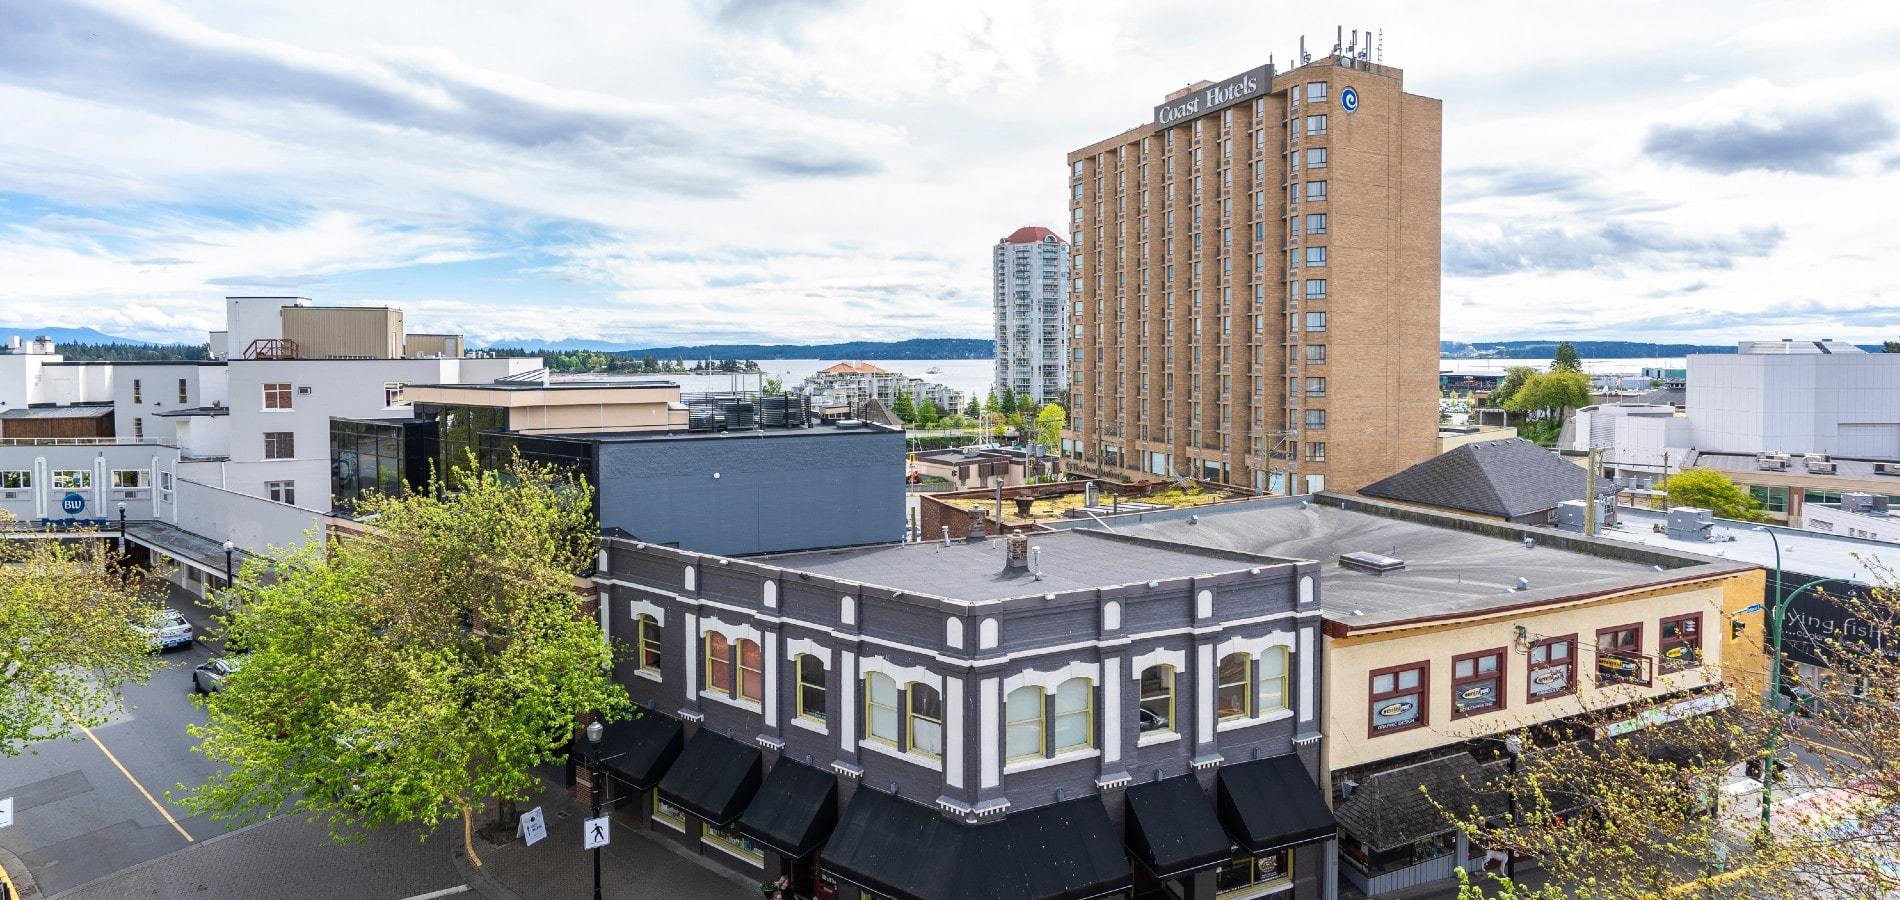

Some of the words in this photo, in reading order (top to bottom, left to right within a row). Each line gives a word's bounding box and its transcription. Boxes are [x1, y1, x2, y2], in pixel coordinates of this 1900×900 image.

[1159, 98, 1199, 124] Coast
[1205, 76, 1257, 109] Hotels
[64, 500, 82, 510] BW
